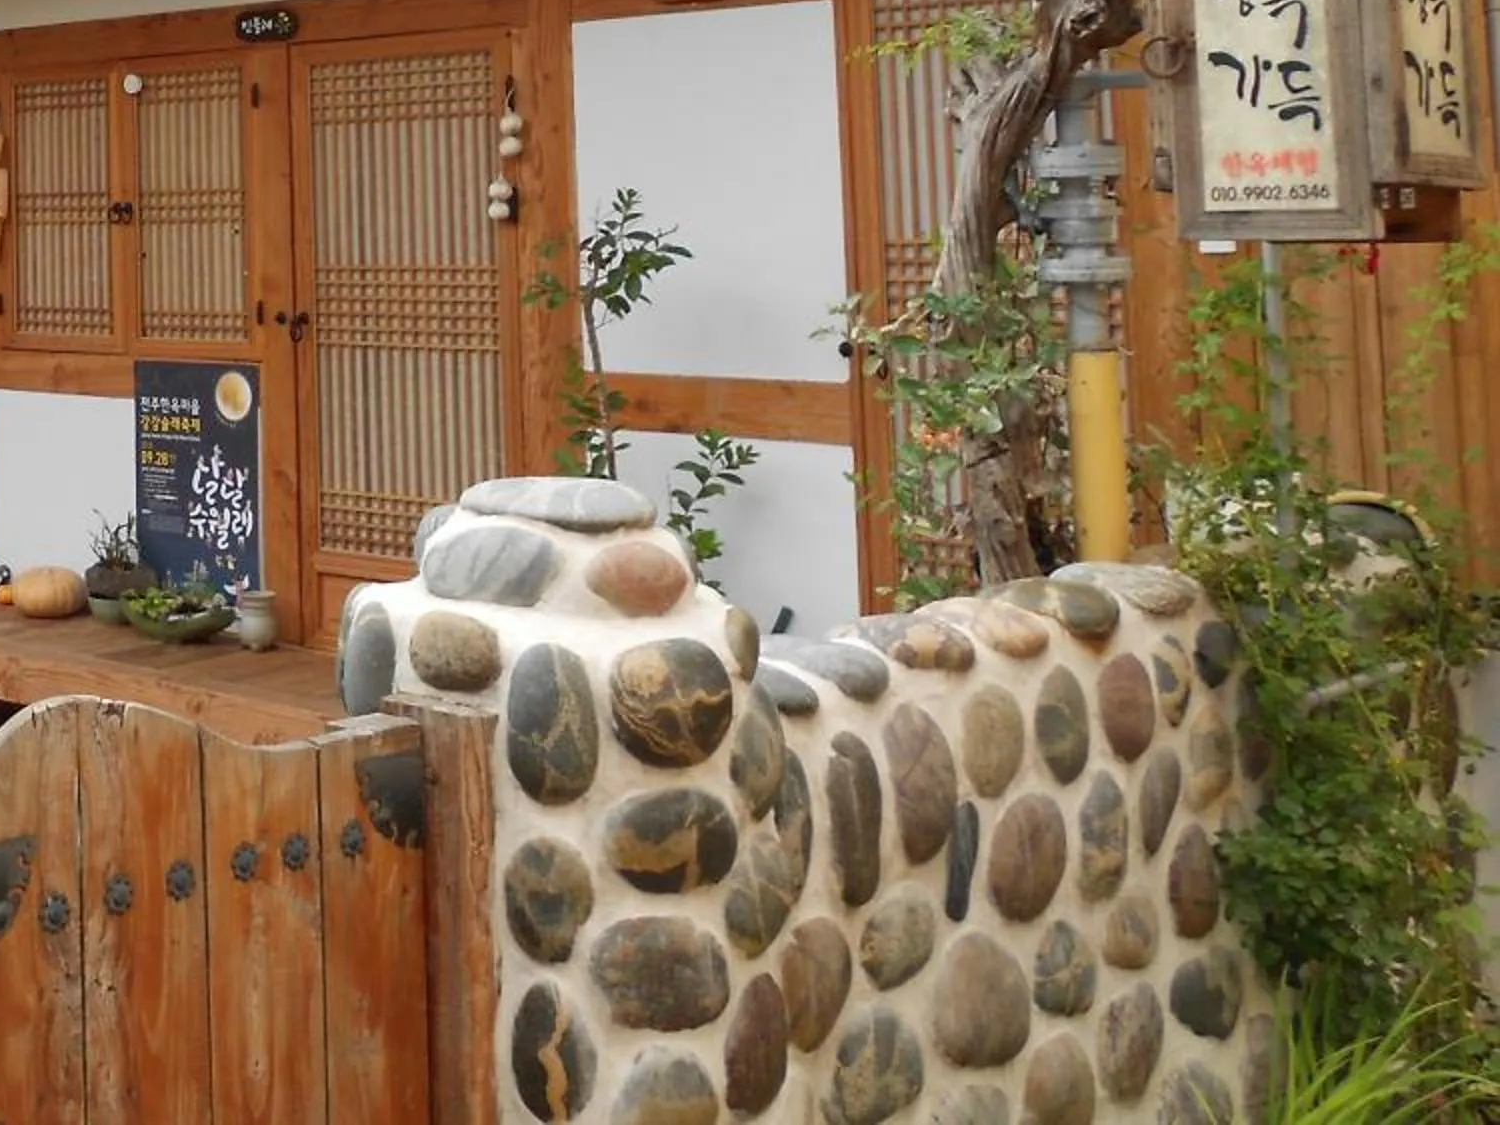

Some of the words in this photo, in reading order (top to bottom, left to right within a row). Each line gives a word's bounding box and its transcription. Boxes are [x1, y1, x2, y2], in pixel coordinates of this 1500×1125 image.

[1209, 52, 1324, 131] 가득
[1403, 50, 1461, 139] 가득
[1211, 184, 1331, 202] 010.9902.6346
[139, 395, 201, 415] 전주한옥마을
[139, 415, 201, 433] 강강술래축제
